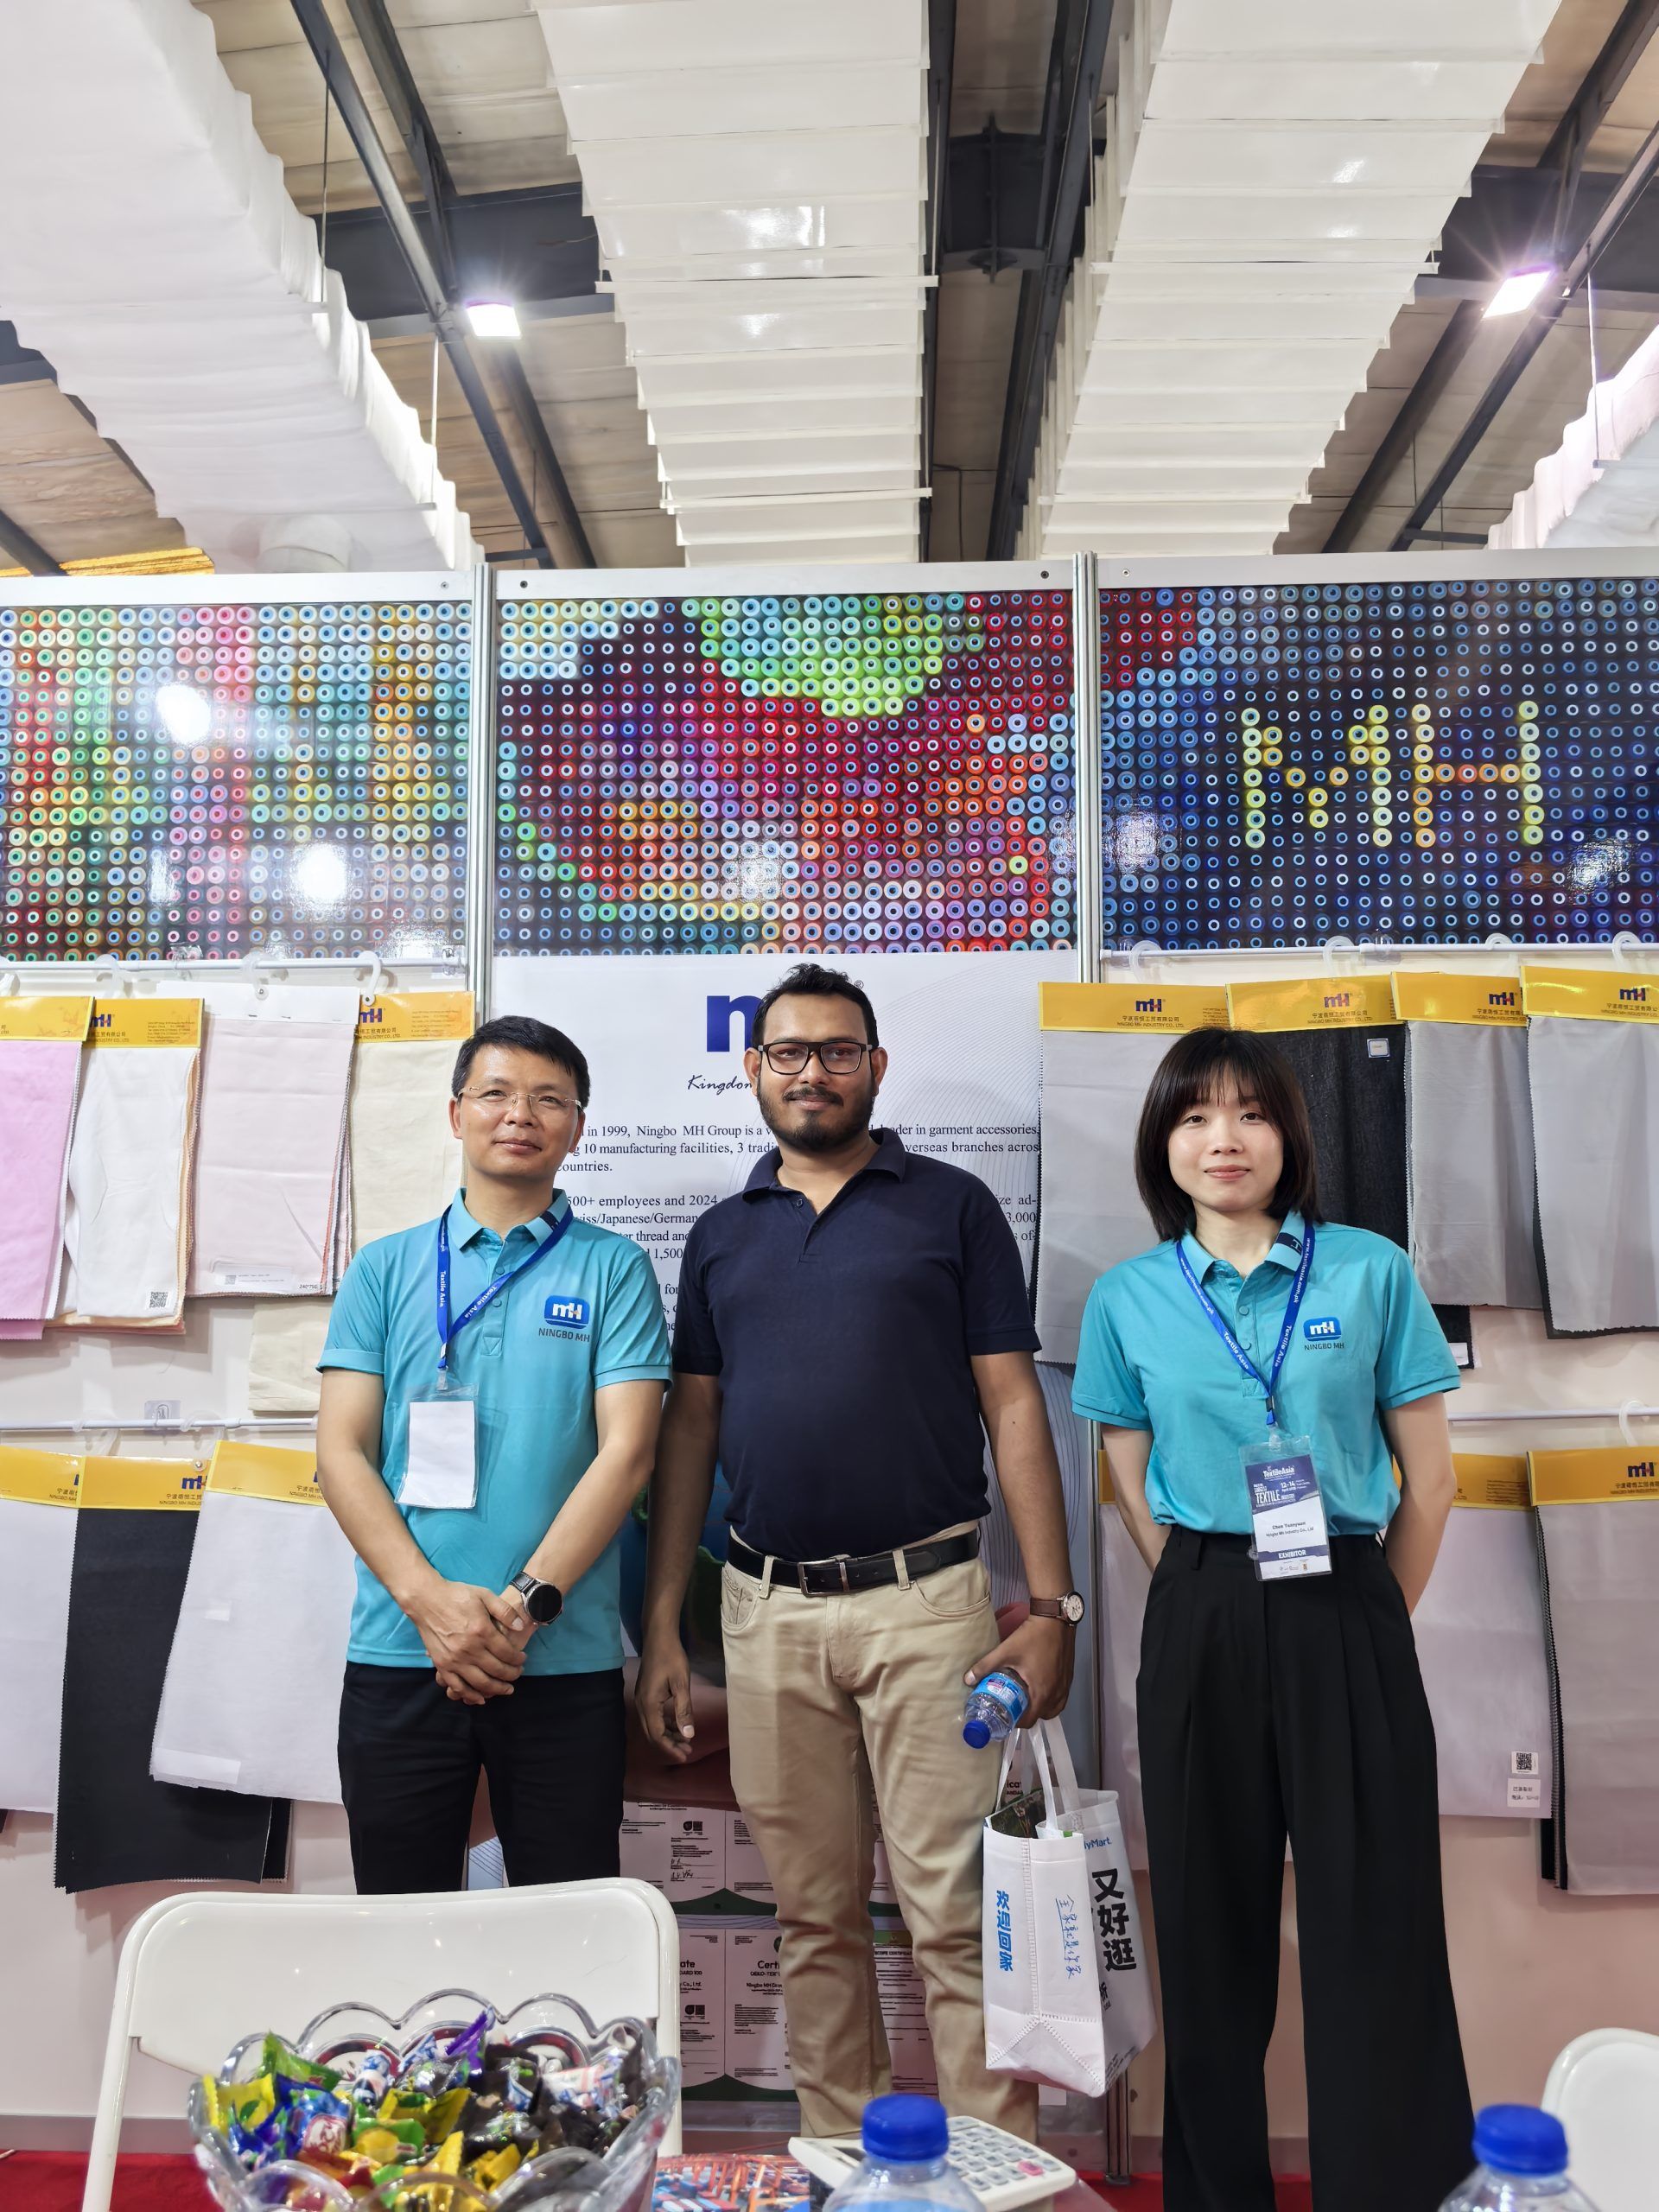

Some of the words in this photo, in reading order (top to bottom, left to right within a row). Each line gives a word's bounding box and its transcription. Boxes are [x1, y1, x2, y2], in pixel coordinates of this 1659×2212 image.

[588, 1126, 598, 1136] in
[602, 1126, 631, 1138] 1999,
[637, 1125, 677, 1139] Ningbo
[683, 1125, 704, 1135] MH
[708, 1124, 742, 1138] Group
[745, 1124, 753, 1135] is
[756, 1127, 762, 1135] a
[916, 1124, 926, 1135] in
[929, 1125, 973, 1137] garment
[584, 1143, 597, 1154] 10
[600, 1141, 677, 1156] manufacturing
[680, 1142, 733, 1155] facilities,
[737, 1143, 744, 1154] 3
[748, 1141, 778, 1153] tradi
[905, 1144, 949, 1153] verseas
[952, 1141, 1004, 1152] branches
[599, 1195, 661, 1209] employees
[664, 1195, 685, 1206] and
[689, 1194, 718, 1206] 2024
[636, 1230, 669, 1242] thread
[476, 1285, 498, 1306] Textile
[464, 1305, 478, 1319] Asia
[538, 1327, 574, 1340] NINGBO
[575, 1332, 590, 1343] MH
[1281, 1325, 1293, 1350] Textile
[1224, 1331, 1239, 1355] Textile
[1236, 1352, 1249, 1370] Asia
[1304, 1343, 1332, 1351] NINGBO
[1274, 1350, 1284, 1368] Asia
[1255, 1489, 1281, 1505] TEXTILE
[1278, 1549, 1306, 1559] EXHIBITOR
[1091, 1867, 1137, 1972] 又好逛
[996, 1890, 1014, 1972] 欢迎回家
